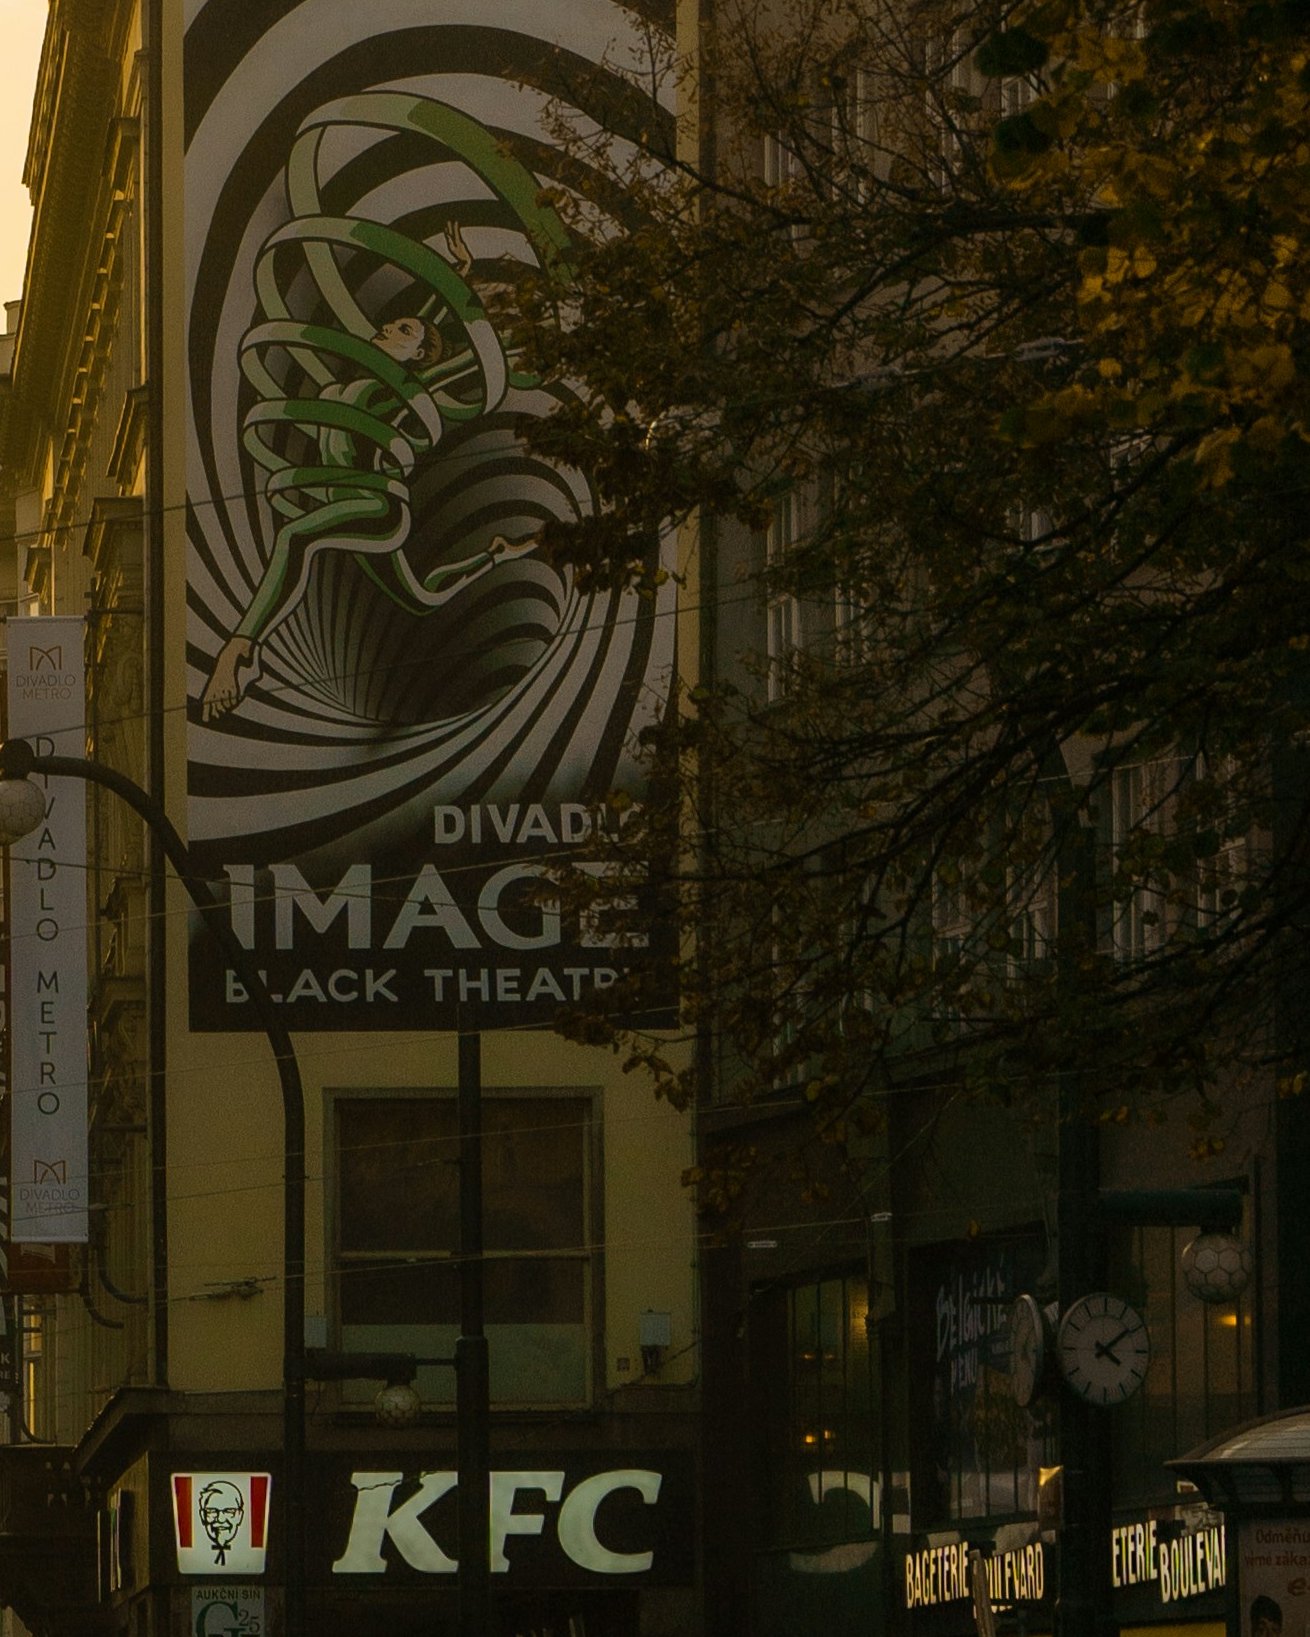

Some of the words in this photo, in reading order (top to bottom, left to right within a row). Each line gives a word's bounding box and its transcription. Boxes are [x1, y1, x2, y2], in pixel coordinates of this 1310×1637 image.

[16, 675, 75, 687] DIVADLO
[22, 688, 71, 700] METRO
[223, 861, 649, 951] IMAGE
[226, 968, 399, 1004] BACK
[423, 968, 630, 1003] THEATR
[36, 970, 60, 1116] METRO
[20, 1188, 80, 1201] DIVADLO
[331, 1468, 663, 1574] KFC
[905, 1540, 970, 1609] BAGETERIE
